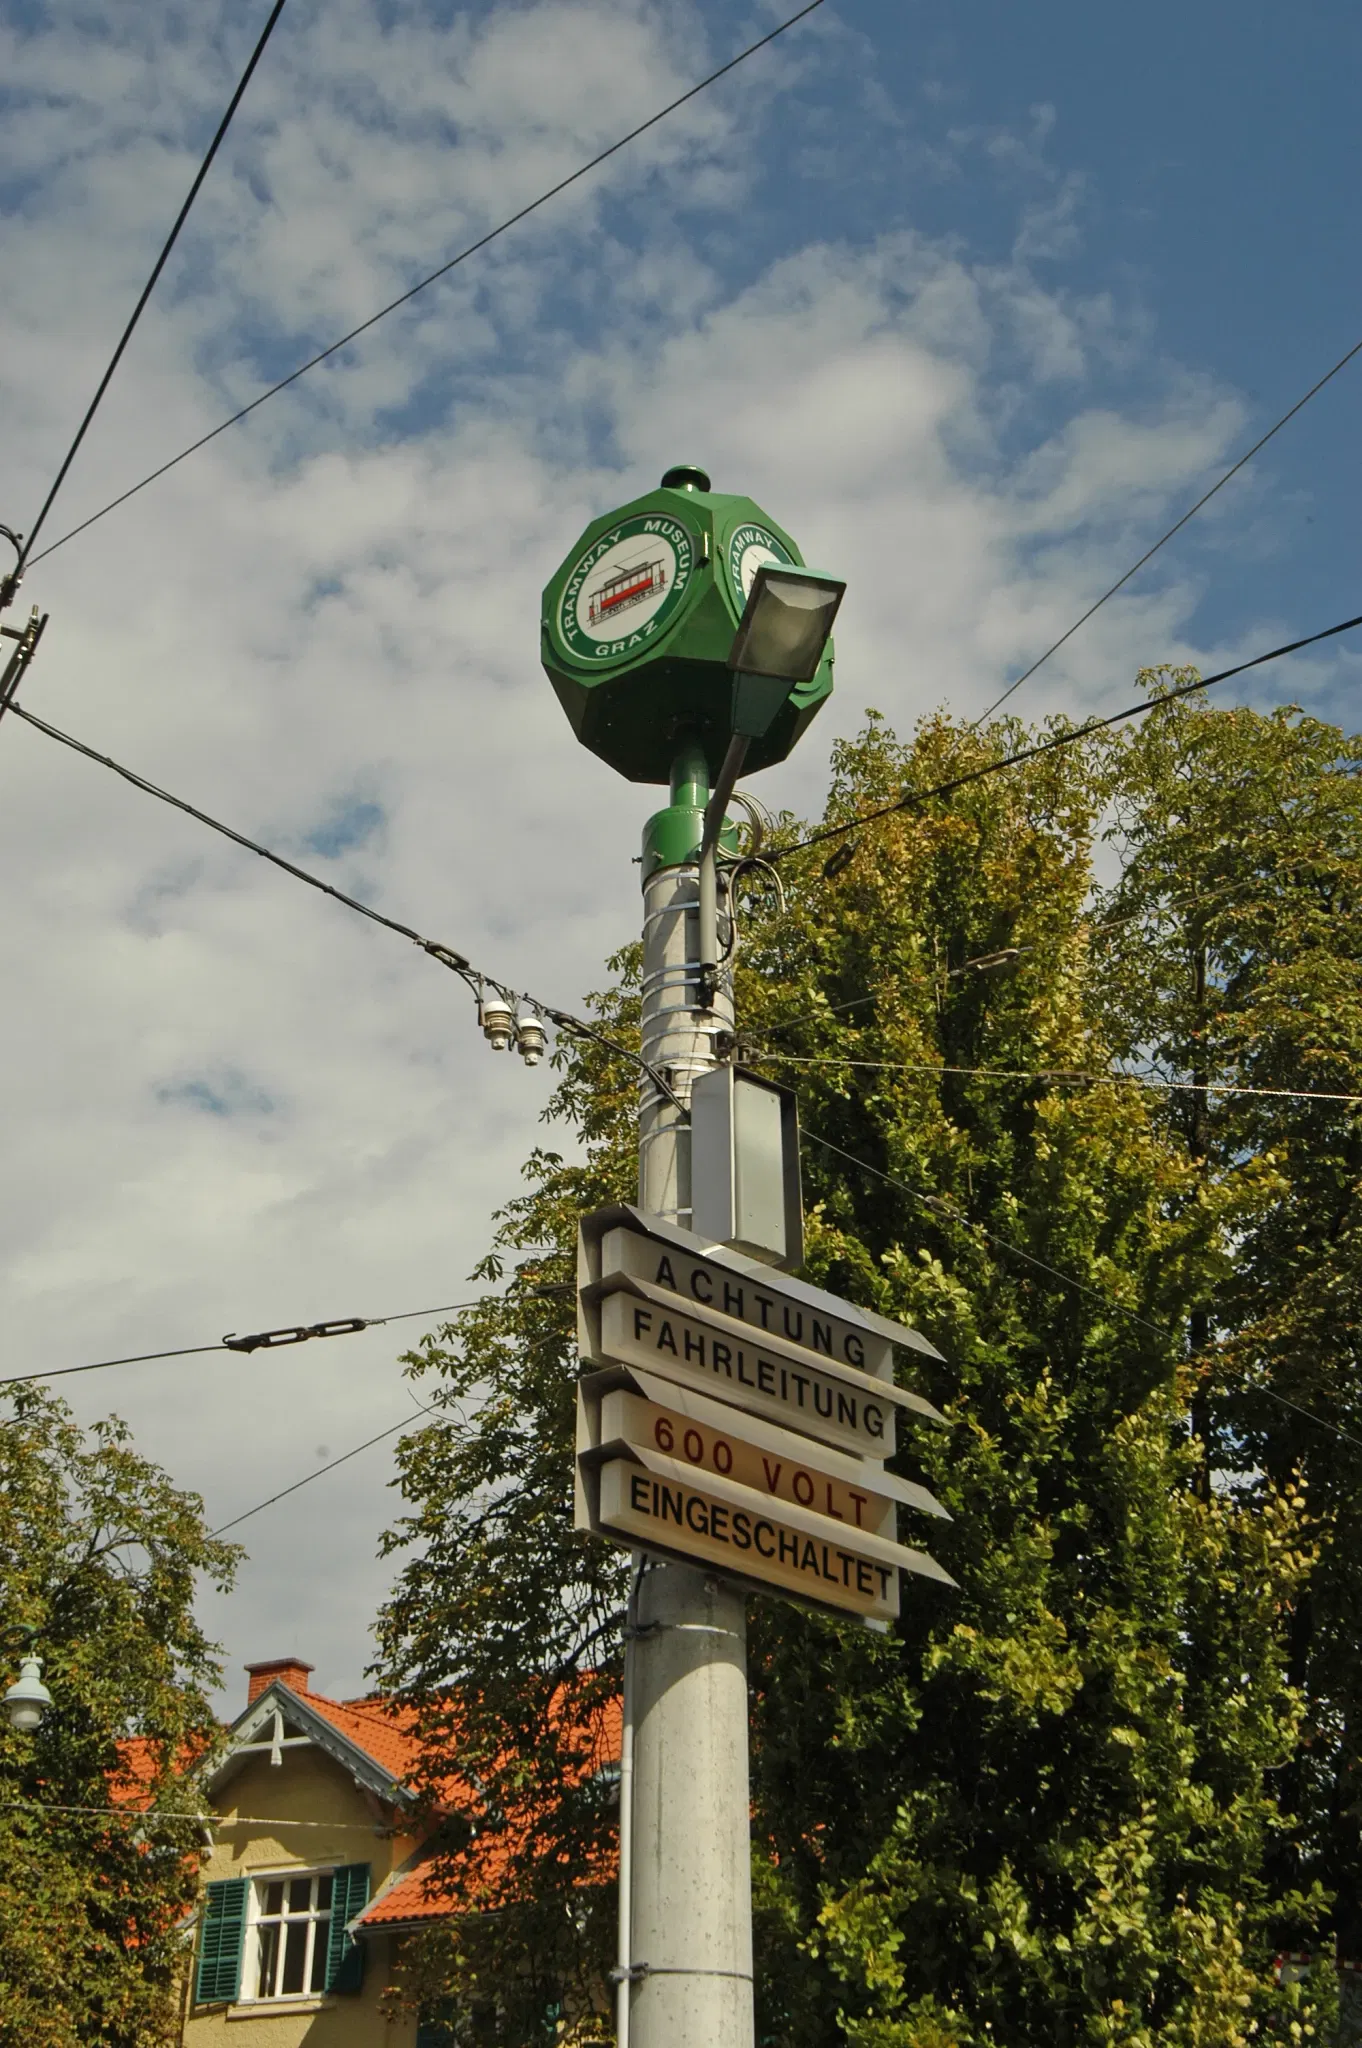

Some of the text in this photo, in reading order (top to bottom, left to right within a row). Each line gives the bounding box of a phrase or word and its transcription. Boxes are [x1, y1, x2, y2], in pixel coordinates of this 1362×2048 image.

[561, 520, 692, 641] TRAMWAY MUSEUM
[733, 530, 773, 593] TRAMWAY
[595, 621, 659, 656] GRAZ
[656, 1255, 865, 1369] ACHTUNG
[633, 1308, 884, 1439] FAHRLEITUNG
[655, 1417, 868, 1528] 600 VOLT
[631, 1475, 892, 1601] EINGESCHALTET
